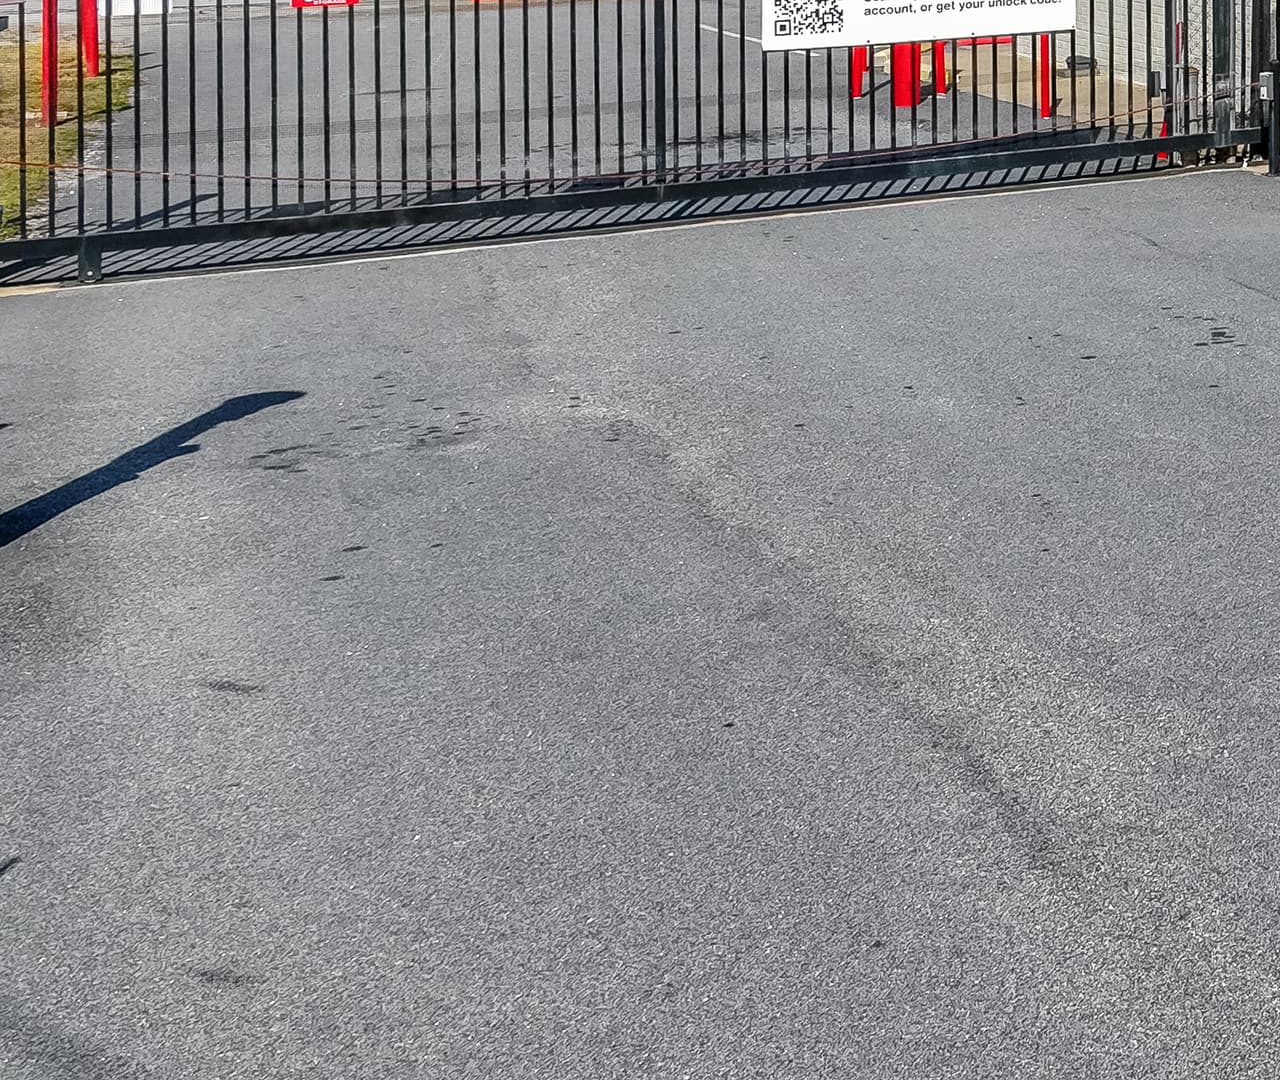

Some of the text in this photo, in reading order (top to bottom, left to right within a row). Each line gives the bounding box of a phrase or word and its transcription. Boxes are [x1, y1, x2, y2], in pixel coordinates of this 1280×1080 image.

[864, 3, 916, 16] account,
[920, 4, 933, 12] or
[936, 0, 955, 14] get
[959, 0, 985, 12] your
